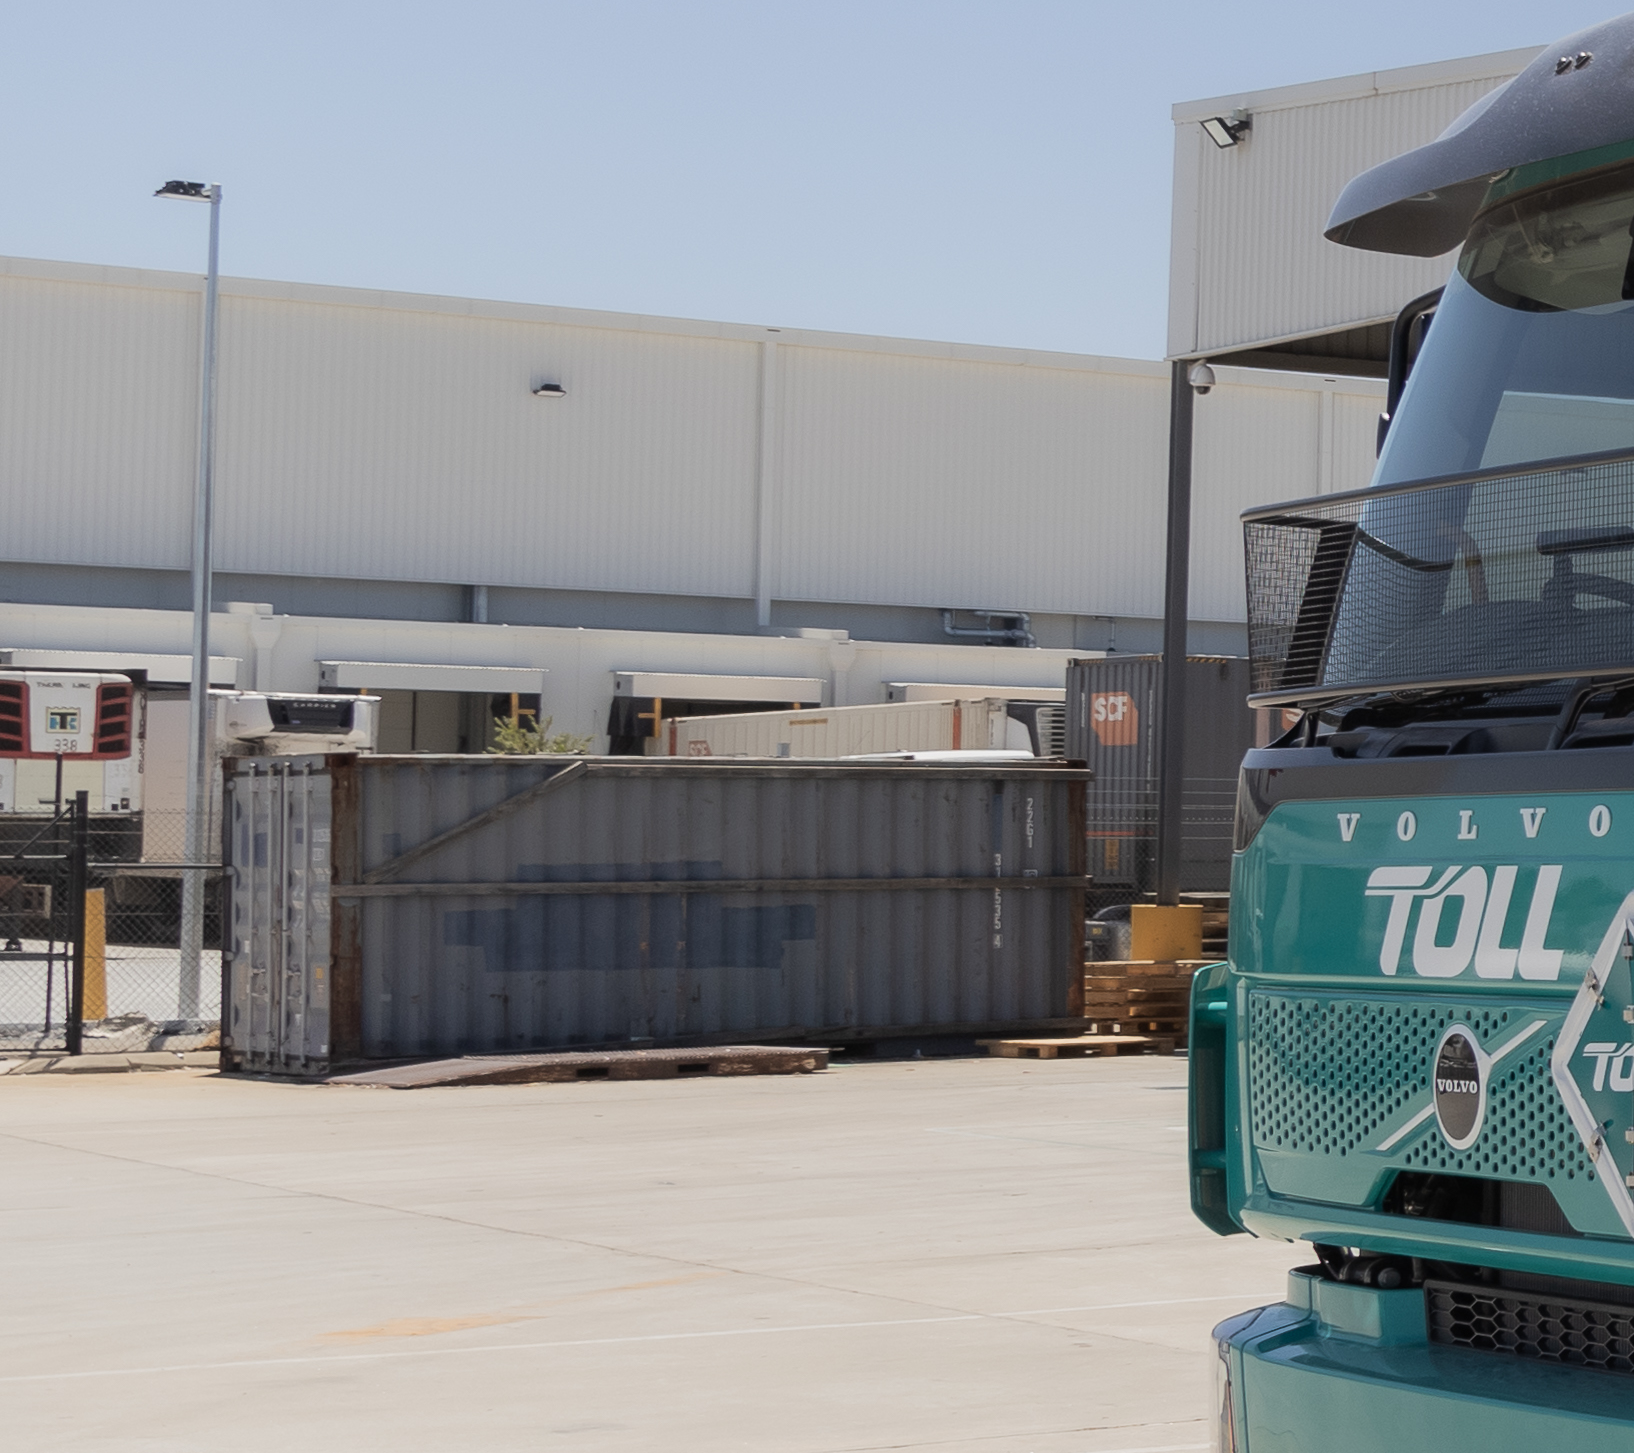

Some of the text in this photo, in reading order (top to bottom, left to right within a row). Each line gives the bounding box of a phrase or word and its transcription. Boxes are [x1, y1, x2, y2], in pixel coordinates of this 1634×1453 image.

[1094, 695, 1128, 722] SCF
[1337, 804, 1613, 842] VOLVO
[1365, 864, 1563, 981] TOLL
[1436, 1078, 1478, 1095] VOLVO
